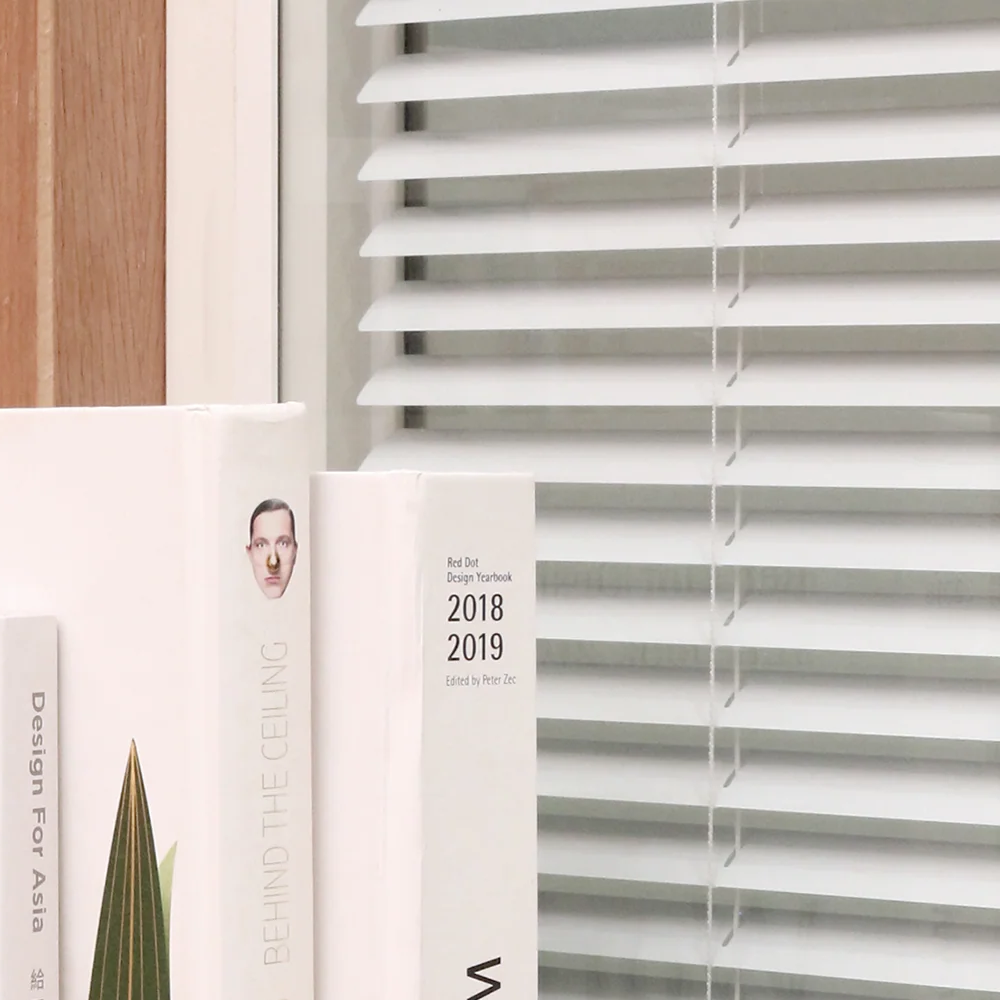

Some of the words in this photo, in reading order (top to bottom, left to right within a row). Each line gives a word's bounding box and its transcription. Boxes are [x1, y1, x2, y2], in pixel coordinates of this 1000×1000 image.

[447, 557, 462, 568] Red
[465, 557, 479, 568] Dot
[447, 572, 474, 586] Design
[476, 572, 512, 583] Yearbook
[447, 593, 504, 622] 2018
[447, 632, 504, 662] 2019
[260, 640, 289, 762] CEILING
[446, 675, 470, 687] Edited
[471, 675, 481, 688] by
[482, 674, 501, 686] Peter
[503, 674, 517, 685] Zec
[29, 691, 46, 796] Design
[262, 771, 289, 838] THE
[32, 806, 47, 858] For
[32, 868, 47, 934] Asia
[263, 845, 291, 967] BEHIND
